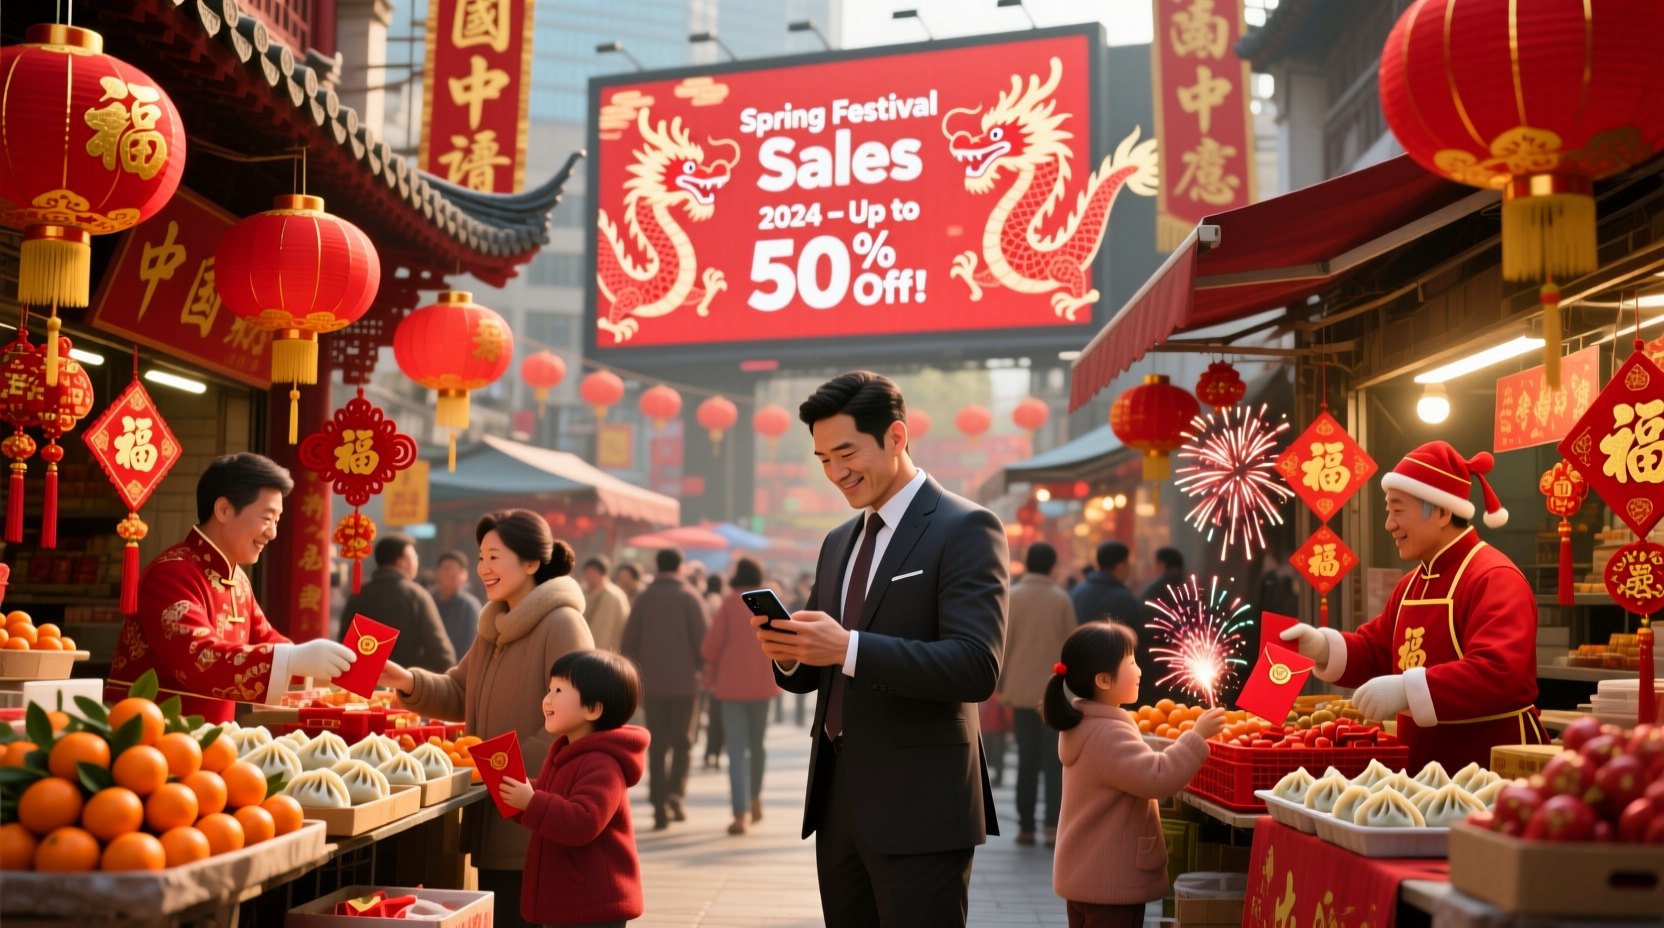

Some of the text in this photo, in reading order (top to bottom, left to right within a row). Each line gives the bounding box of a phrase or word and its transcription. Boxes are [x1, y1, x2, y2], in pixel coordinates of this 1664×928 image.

[84, 76, 168, 180] 福
[740, 89, 938, 138] Spring Festival
[756, 128, 923, 192] Sales
[758, 202, 823, 230] 2024
[849, 198, 886, 229] Up
[890, 198, 920, 222] to
[853, 268, 927, 306] Off!
[113, 415, 158, 473] 福
[334, 429, 380, 475] 福
[1599, 399, 1664, 484] 福
[1301, 441, 1351, 493] 福
[1308, 543, 1340, 577] 福
[1398, 626, 1427, 671] 福
